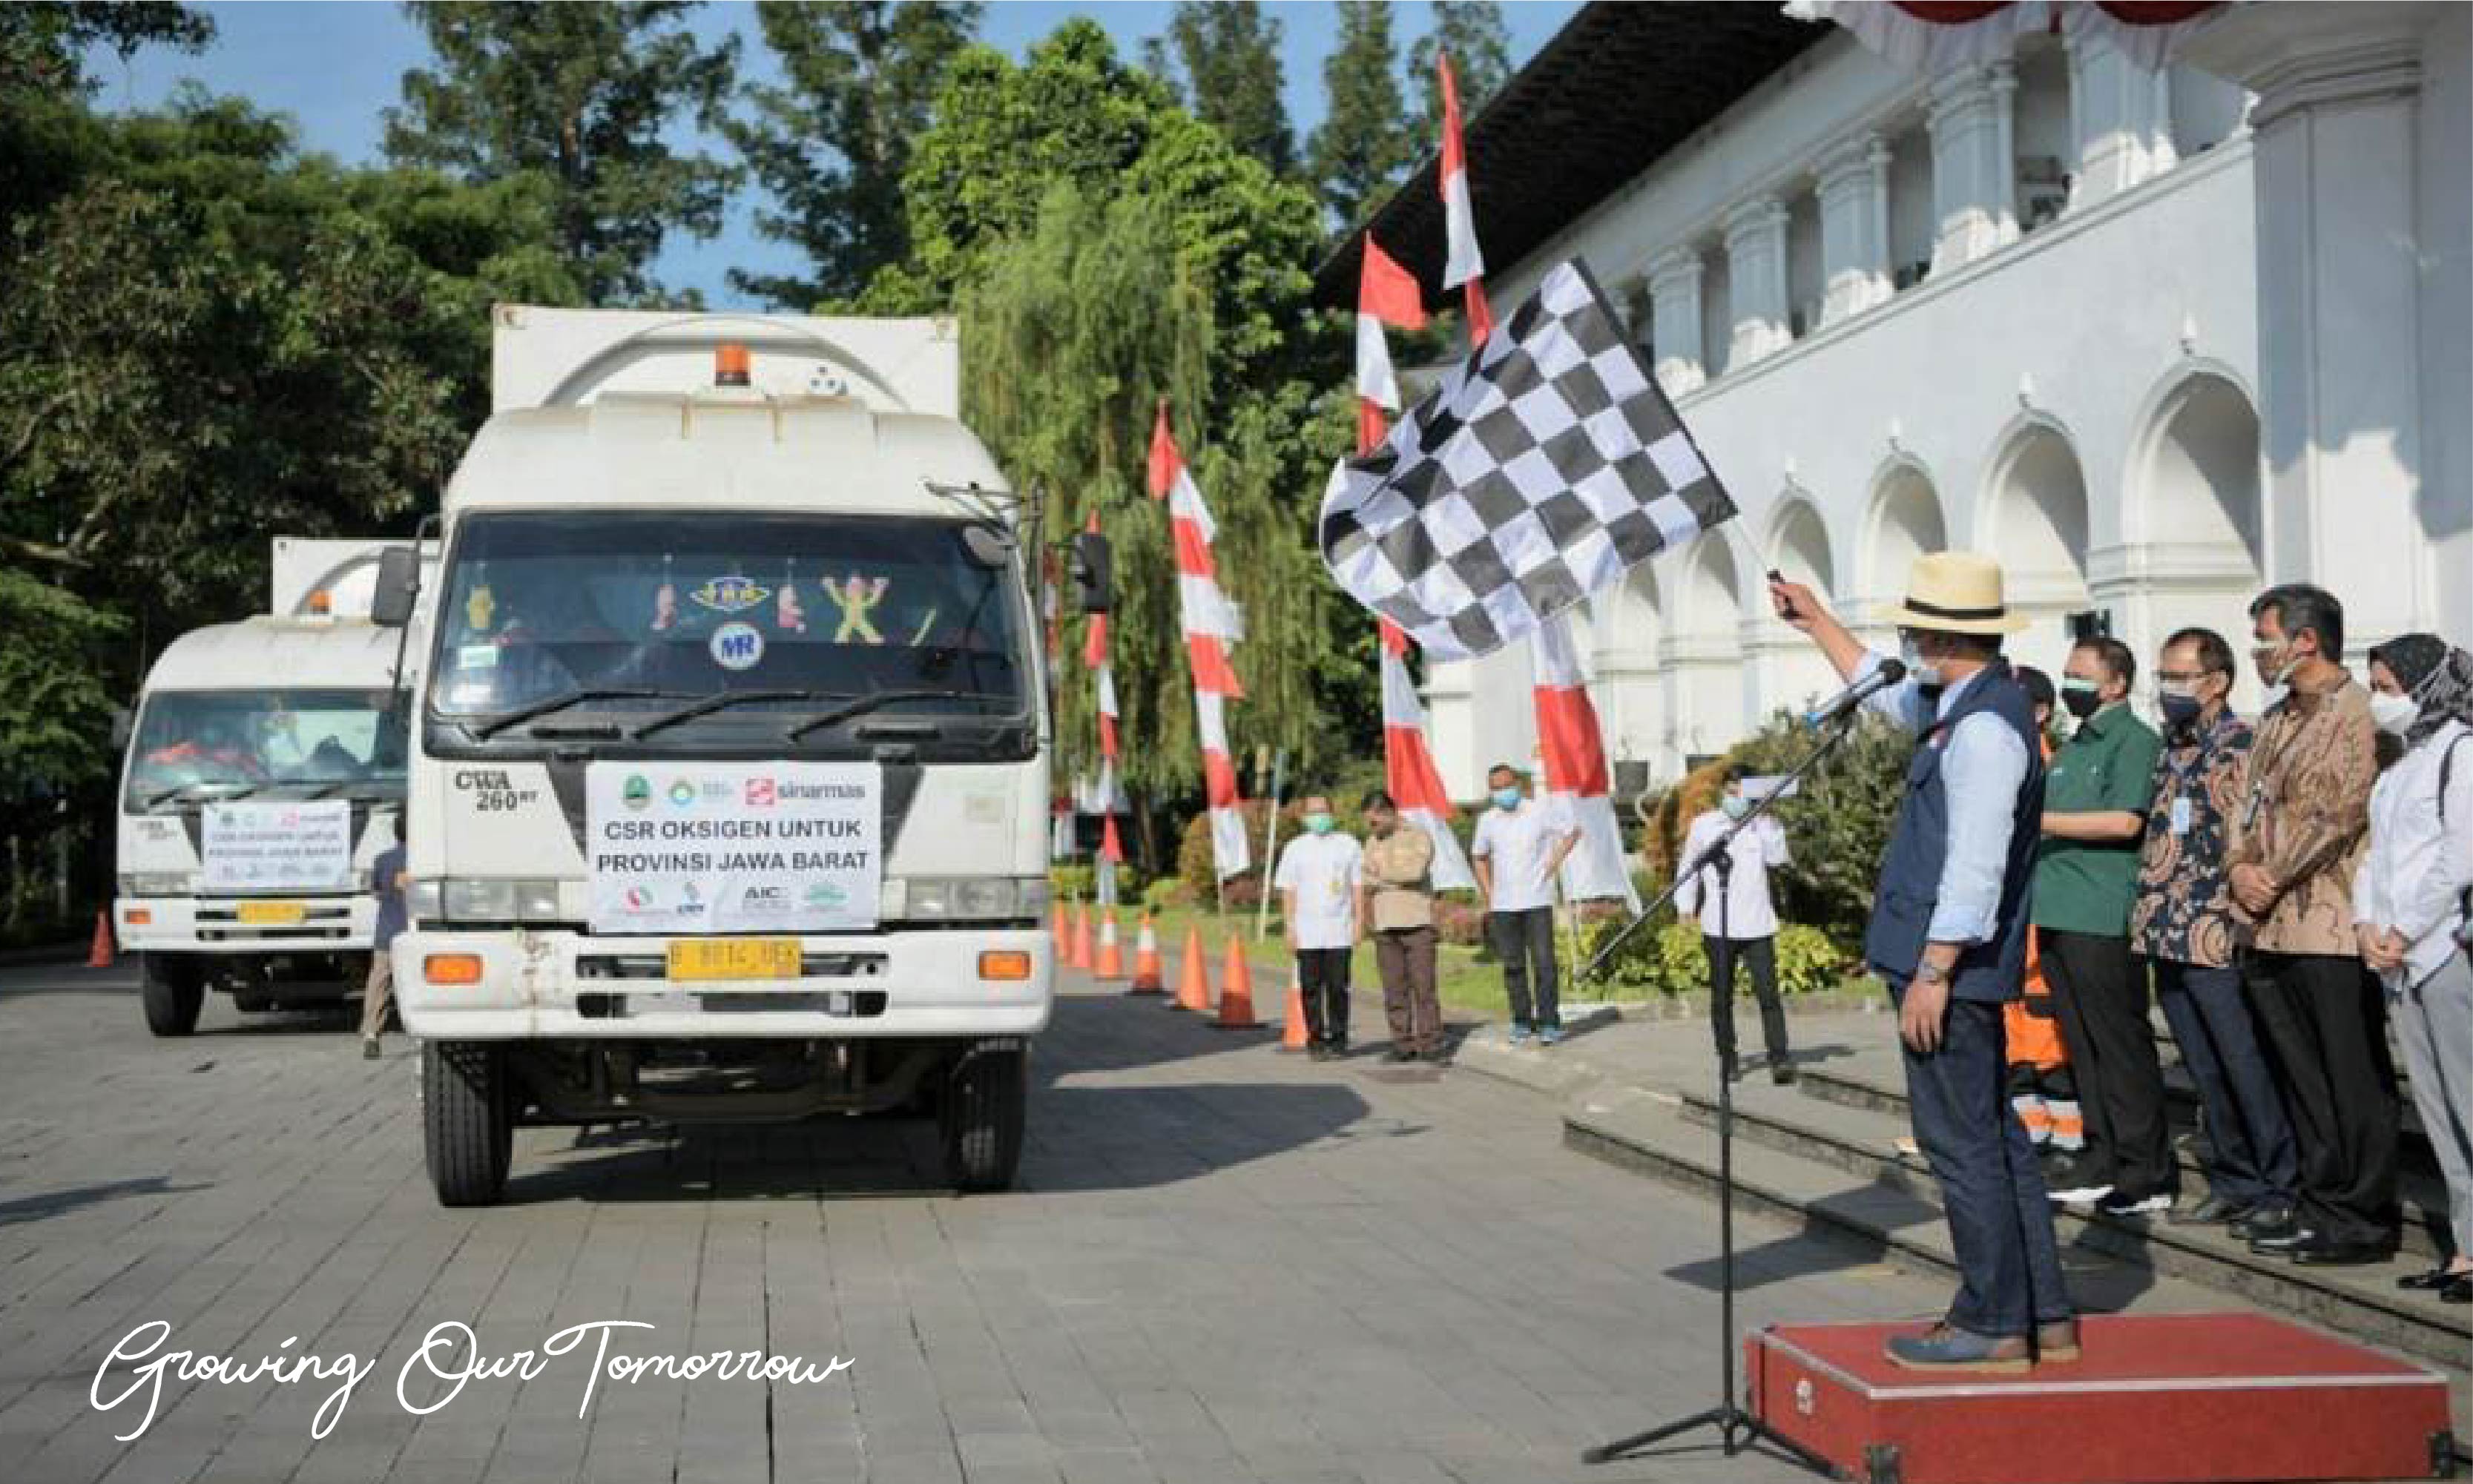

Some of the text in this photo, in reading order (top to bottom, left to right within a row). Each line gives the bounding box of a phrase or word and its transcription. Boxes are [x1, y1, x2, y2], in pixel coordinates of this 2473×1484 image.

[454, 770, 512, 790] CWA
[604, 820, 862, 840] CSR OKSIGEN UNTUK
[596, 851, 868, 872] PROVINSI JAWA BARAT
